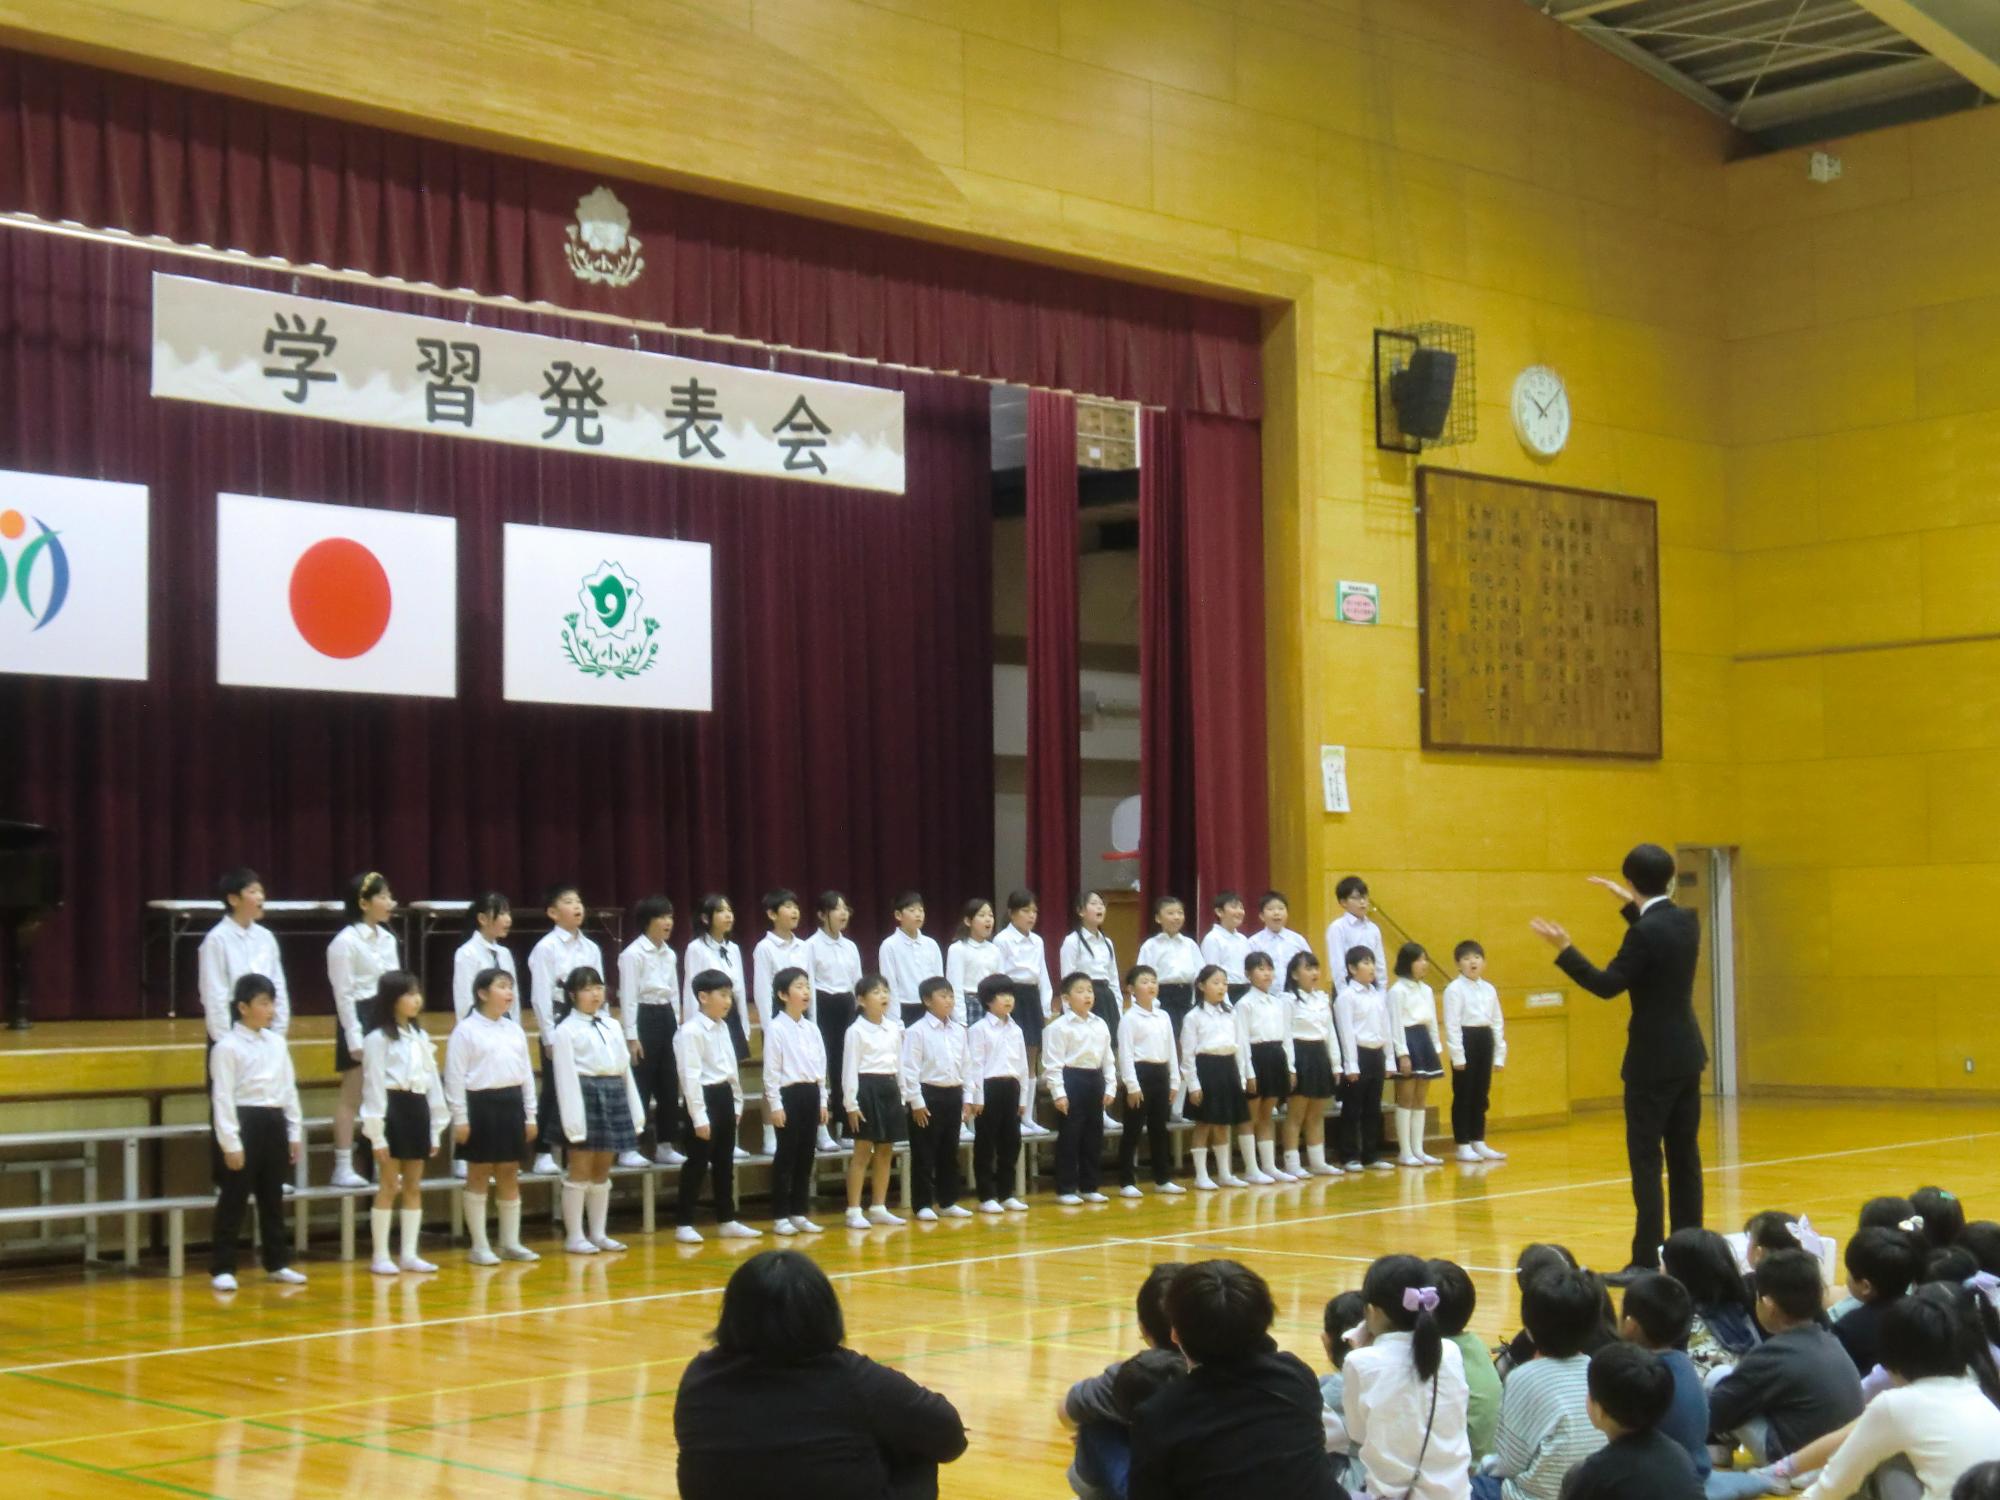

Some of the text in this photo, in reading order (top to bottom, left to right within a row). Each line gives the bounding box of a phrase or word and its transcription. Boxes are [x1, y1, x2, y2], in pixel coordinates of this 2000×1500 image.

[263, 312, 832, 475] 学習発表会
